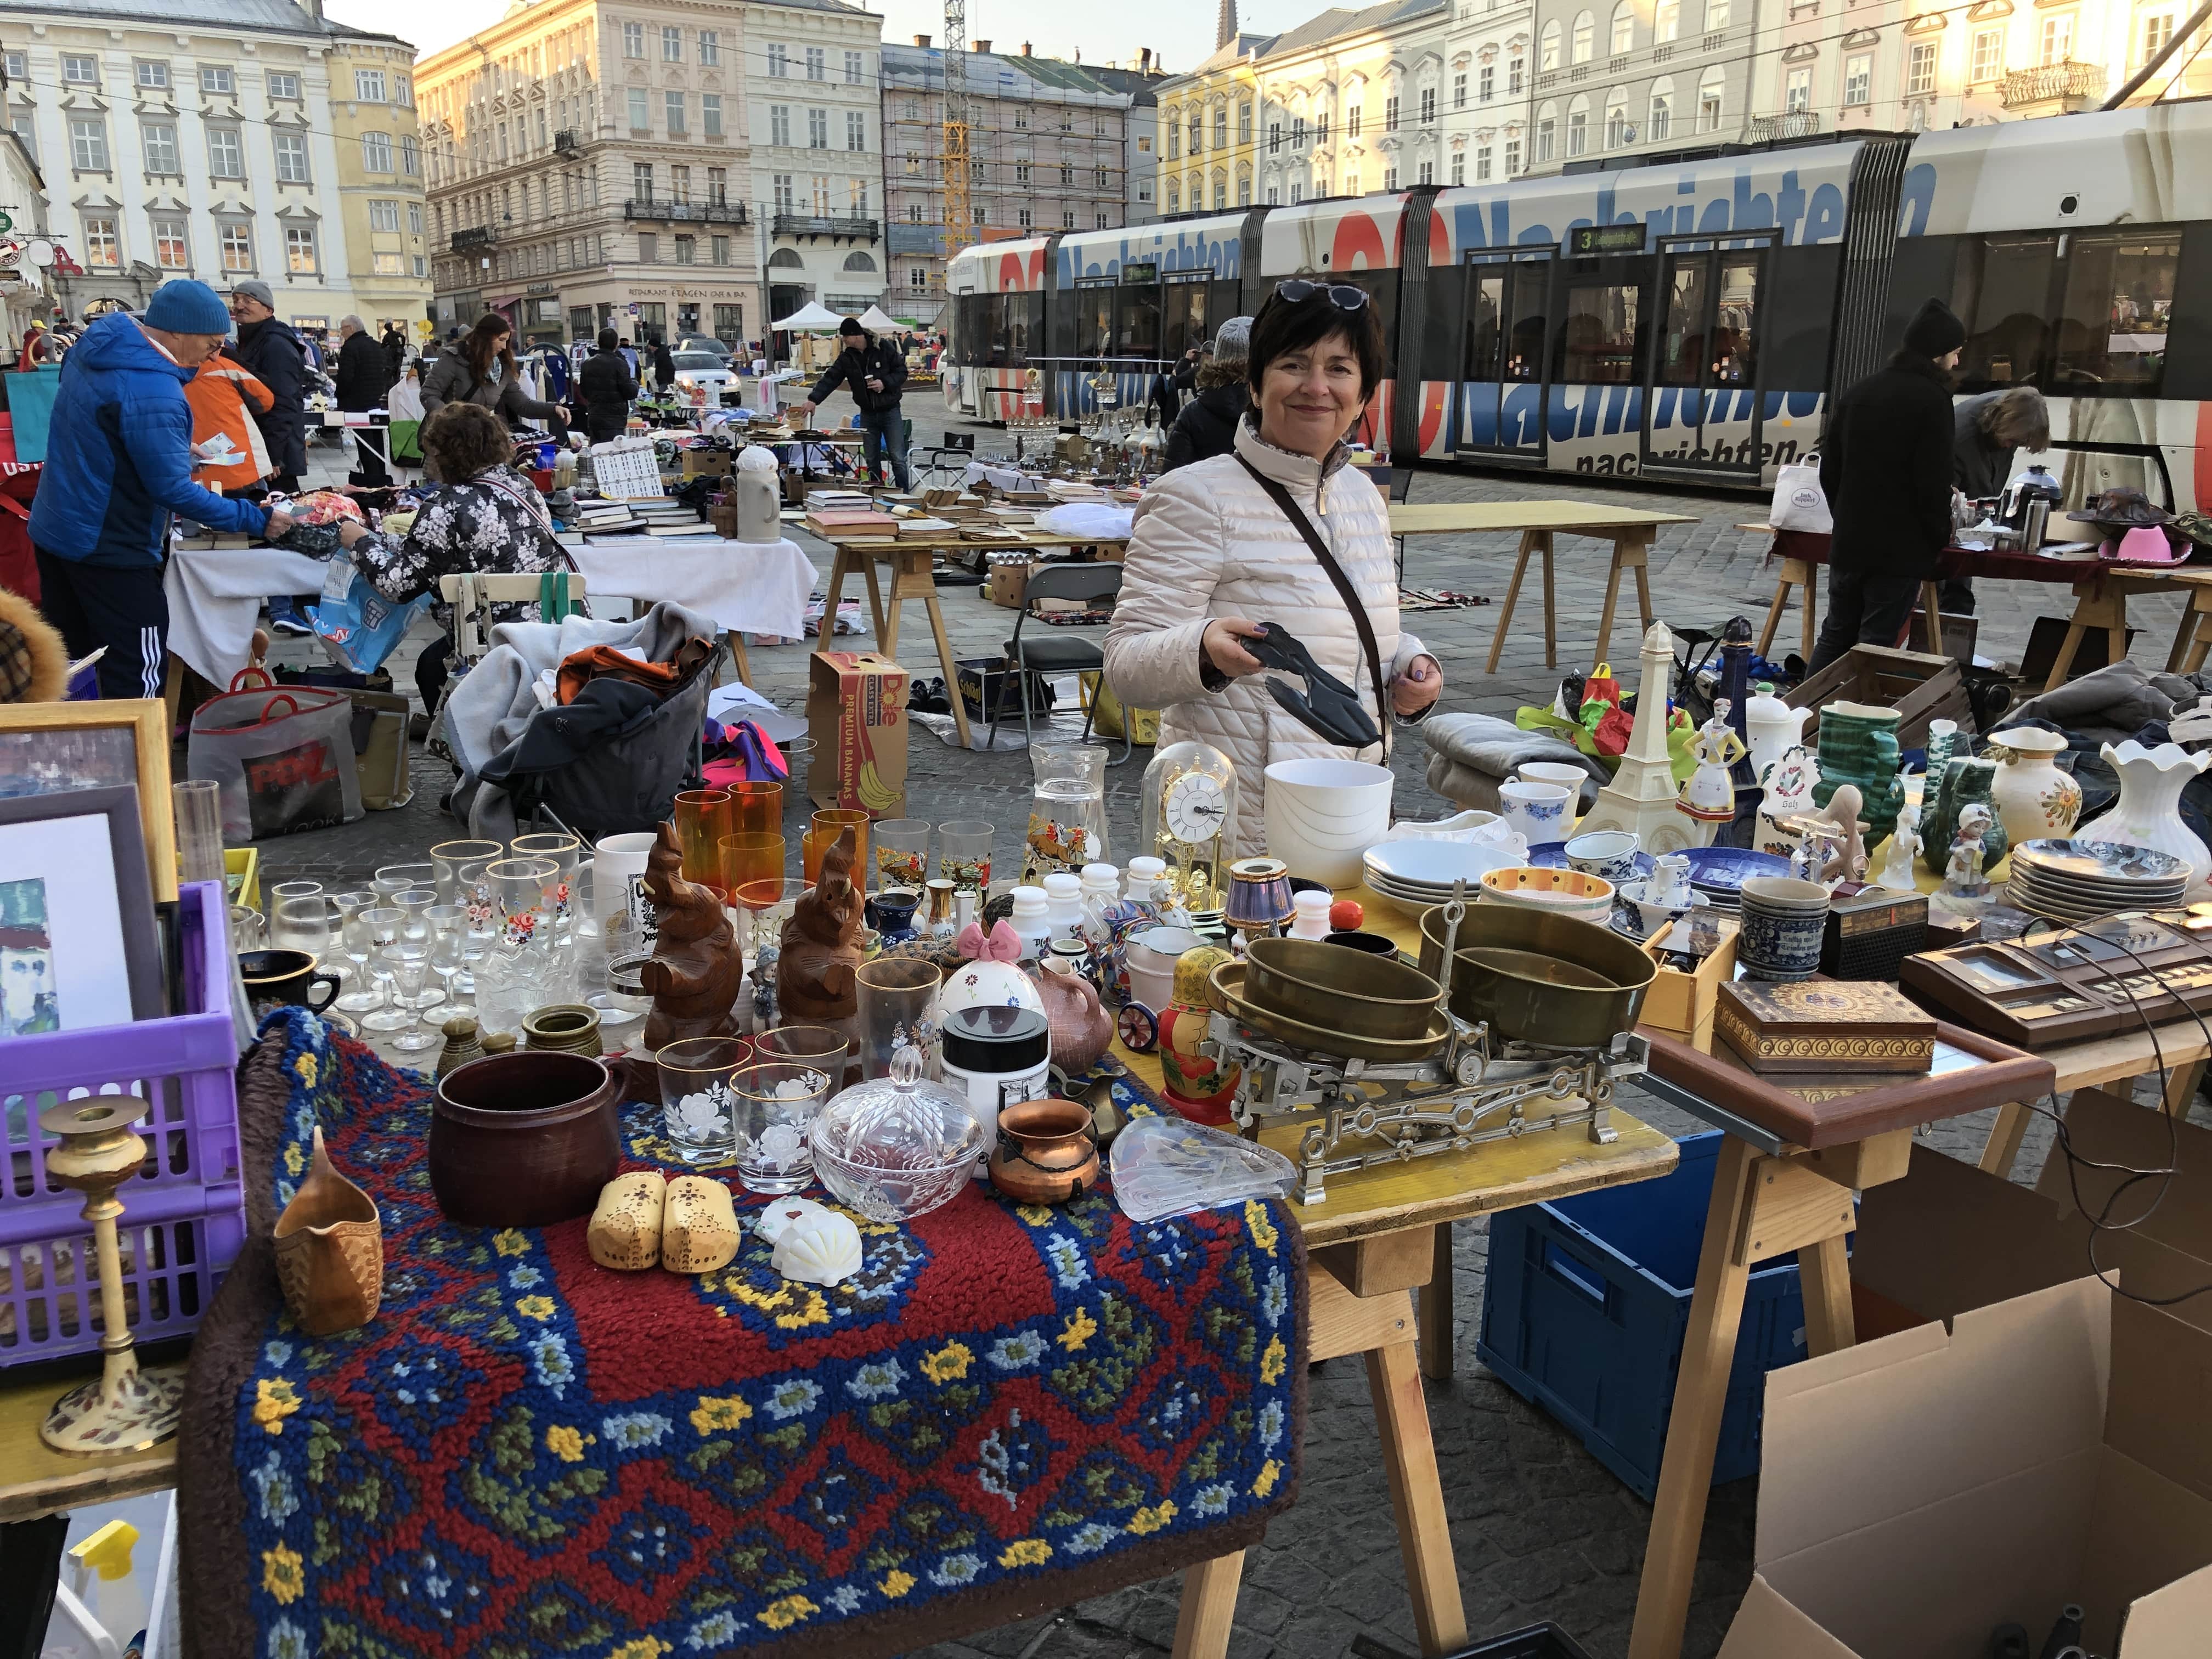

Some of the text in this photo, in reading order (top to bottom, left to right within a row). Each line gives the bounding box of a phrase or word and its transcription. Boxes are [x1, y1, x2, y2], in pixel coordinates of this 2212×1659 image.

[1582, 232, 1591, 249] 3
[882, 675, 903, 727] Dole
[843, 694, 855, 799] PREMIUM BANANAS
